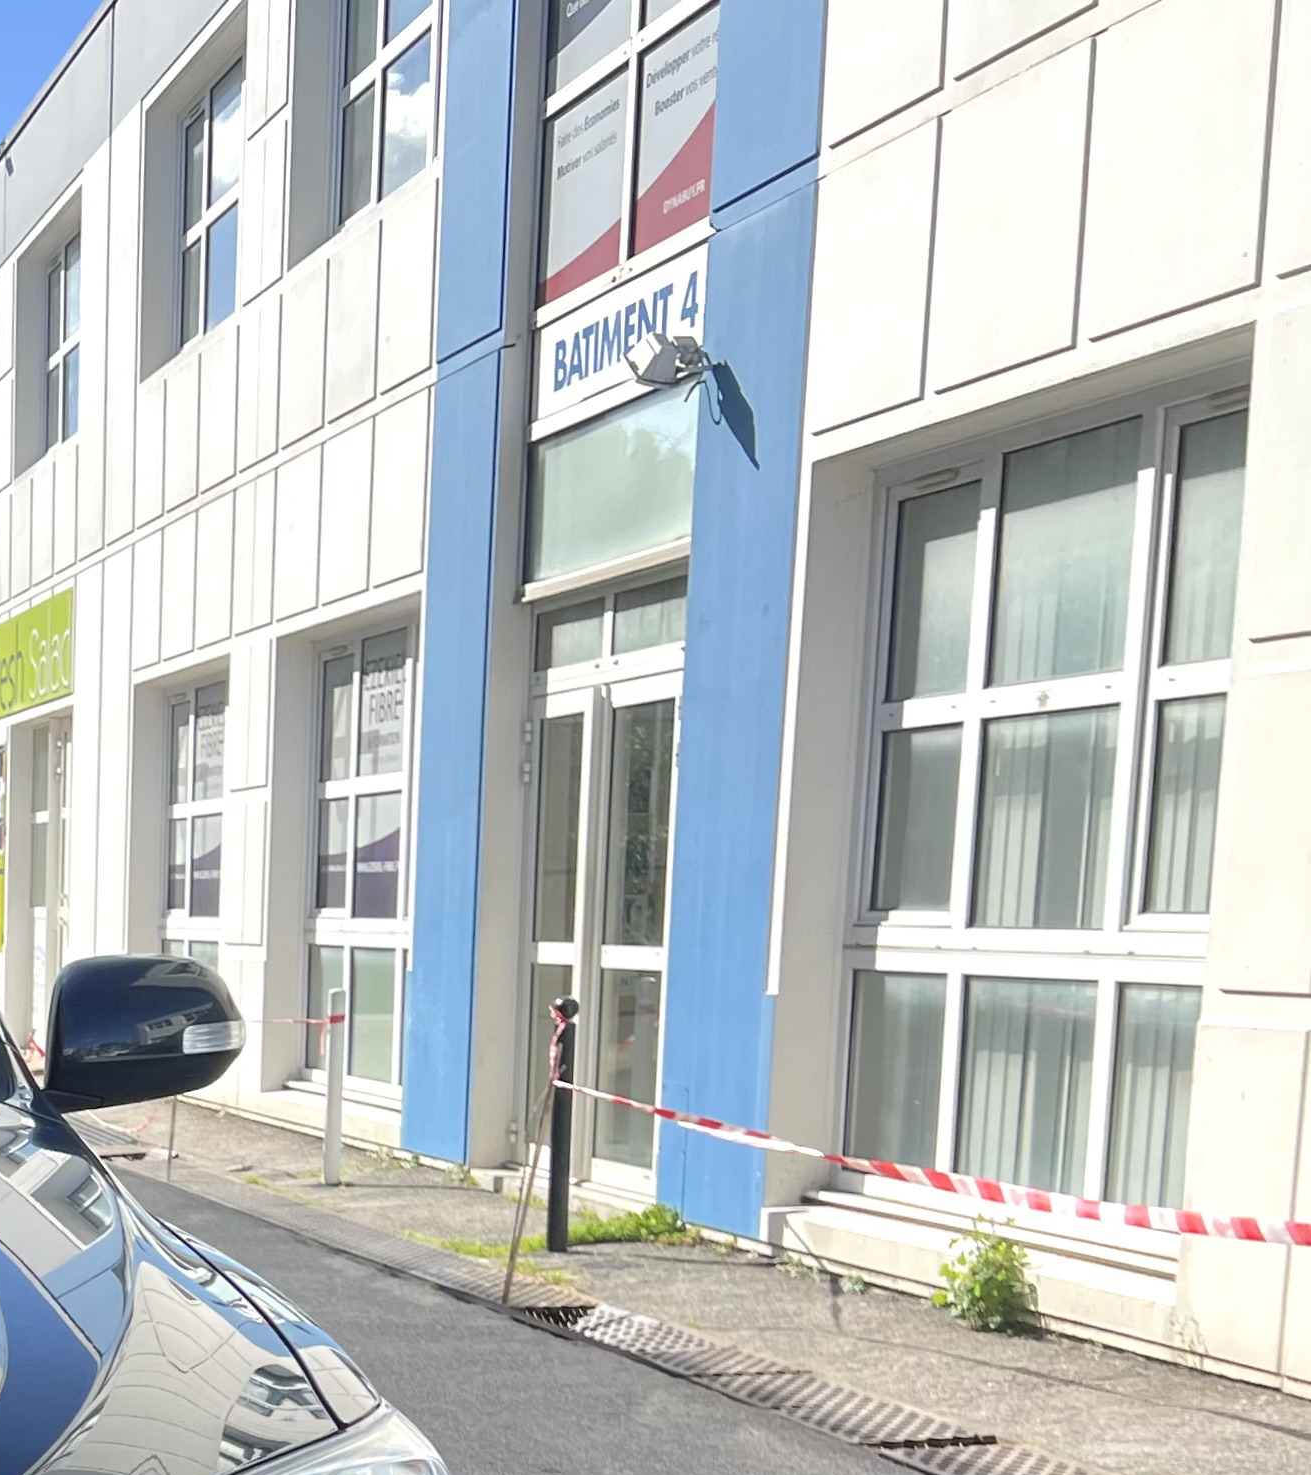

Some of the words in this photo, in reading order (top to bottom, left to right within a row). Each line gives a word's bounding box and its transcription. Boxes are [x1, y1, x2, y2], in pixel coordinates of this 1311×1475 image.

[655, 88, 685, 116] Booster
[553, 283, 674, 393] BATIMENT
[680, 270, 699, 328] 4
